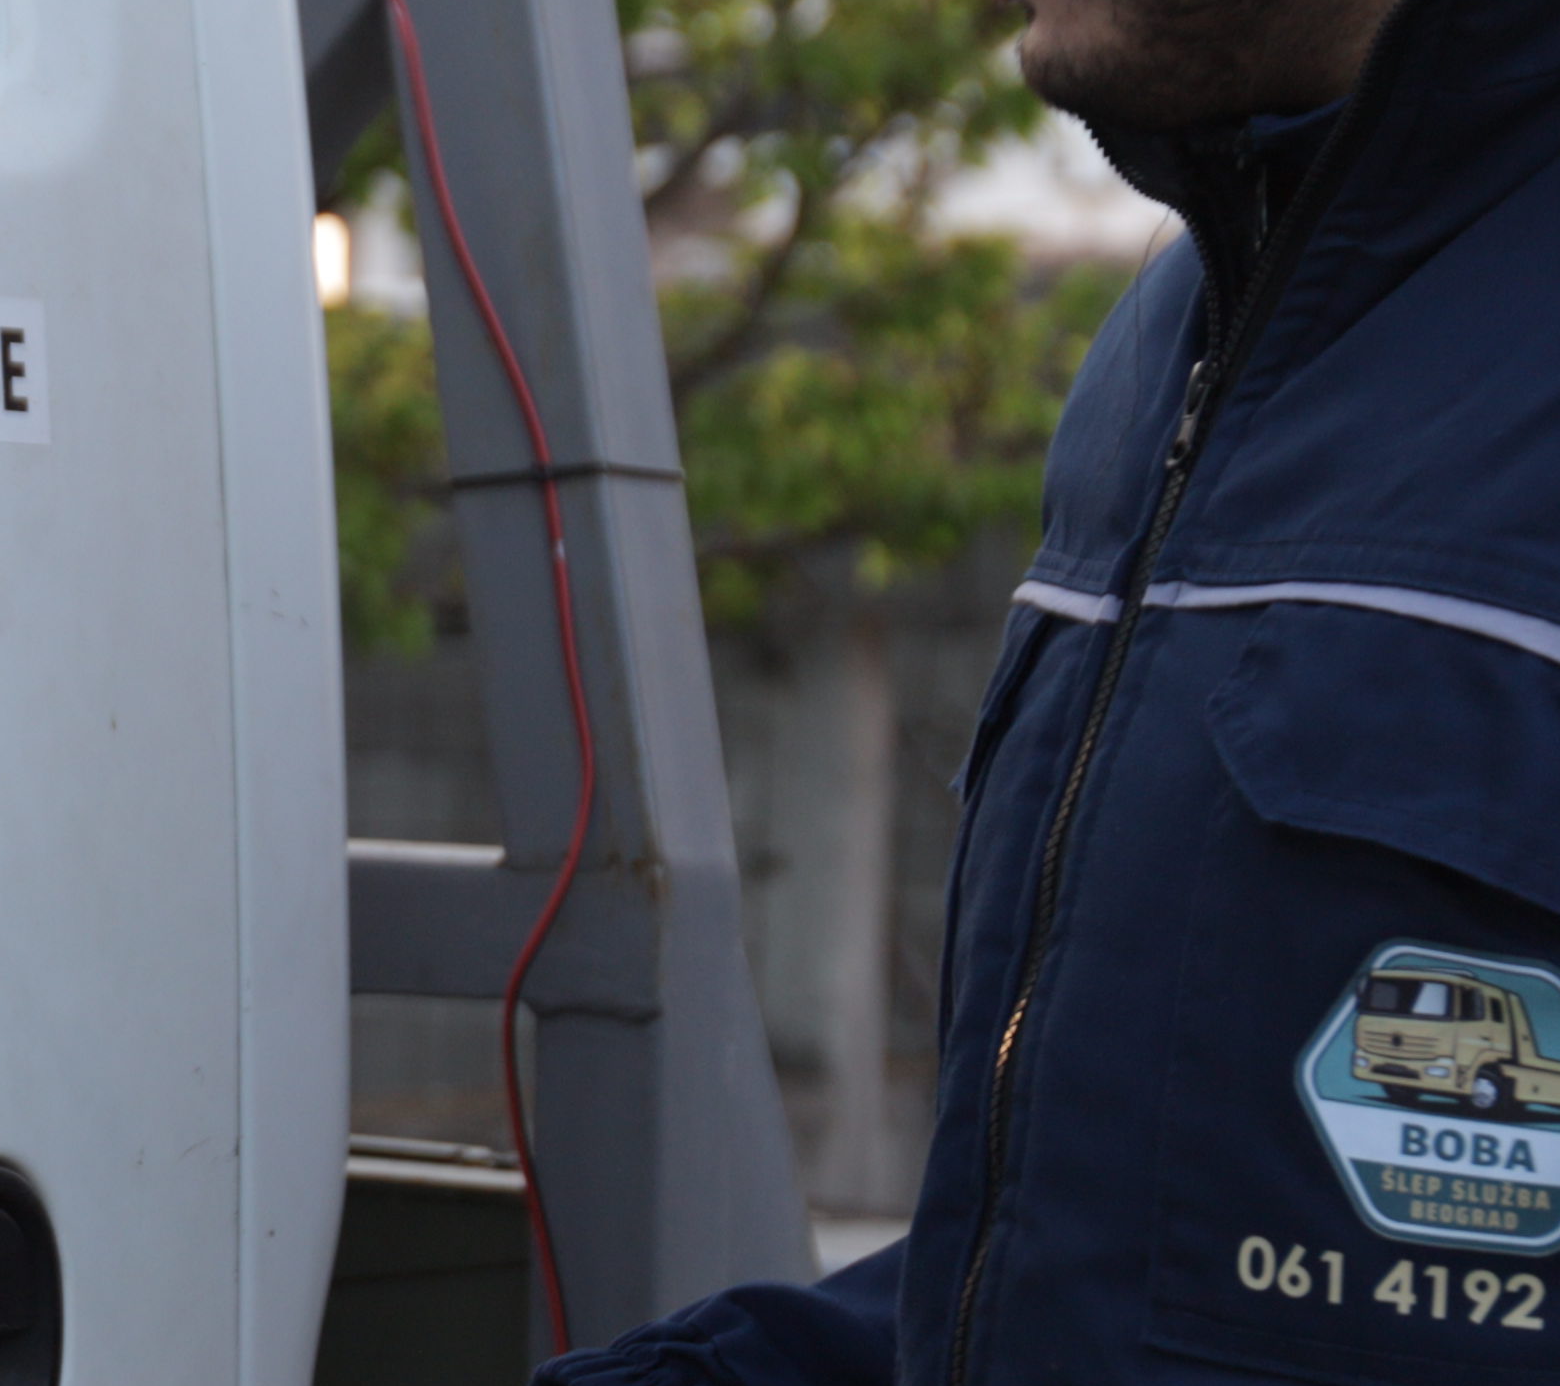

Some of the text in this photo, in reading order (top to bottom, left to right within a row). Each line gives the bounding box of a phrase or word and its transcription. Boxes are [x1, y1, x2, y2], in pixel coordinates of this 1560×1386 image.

[1400, 1122, 1537, 1174] BOBA
[1410, 1198, 1518, 1231] BEOGRAD
[1237, 1234, 1345, 1305] 061
[1373, 1258, 1546, 1331] 4192
